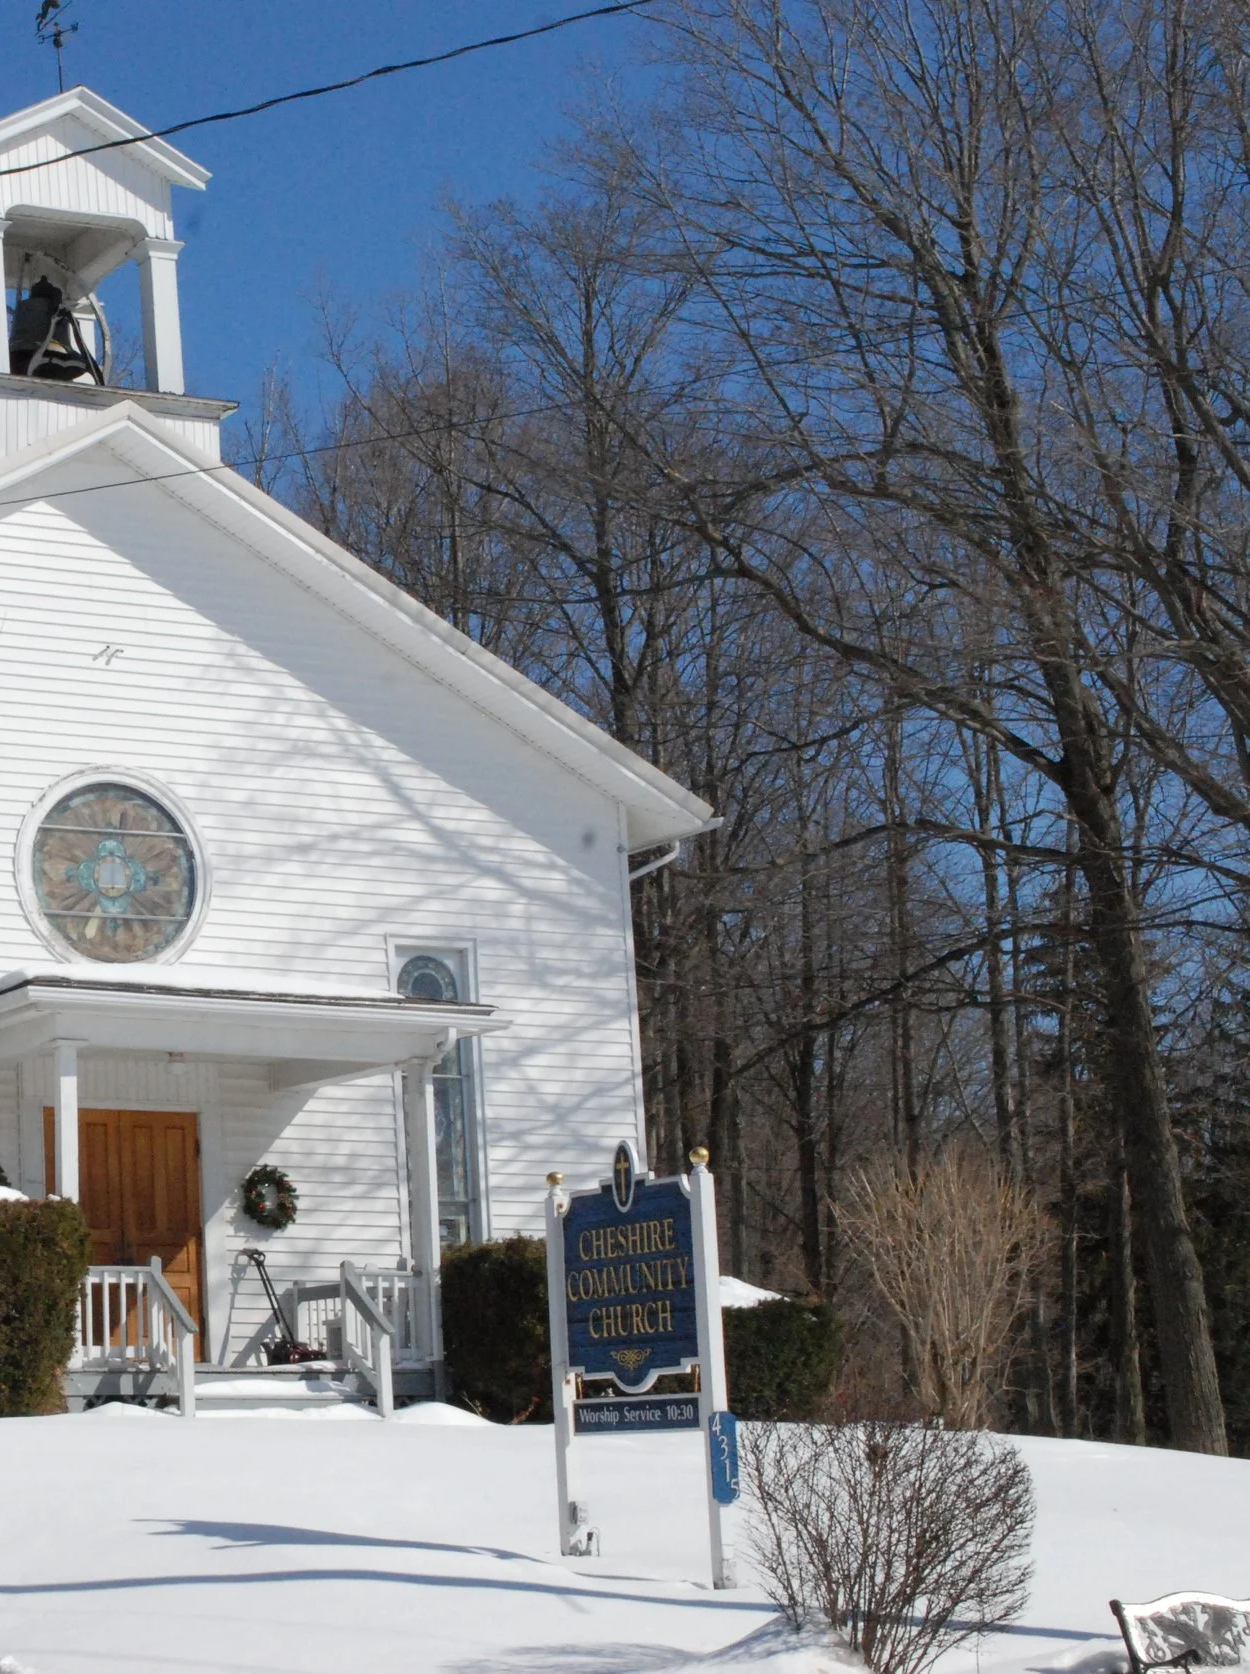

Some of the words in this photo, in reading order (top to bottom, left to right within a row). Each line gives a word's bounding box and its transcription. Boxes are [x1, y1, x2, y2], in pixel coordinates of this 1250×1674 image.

[579, 1218, 675, 1260] CHESHIRE
[567, 1256, 689, 1301] COMMUNITY
[590, 1300, 673, 1338] CHURCH
[579, 1407, 620, 1425] Worship
[623, 1404, 662, 1422] Service
[666, 1404, 694, 1420] 10:30
[712, 1412, 739, 1499] 4315
